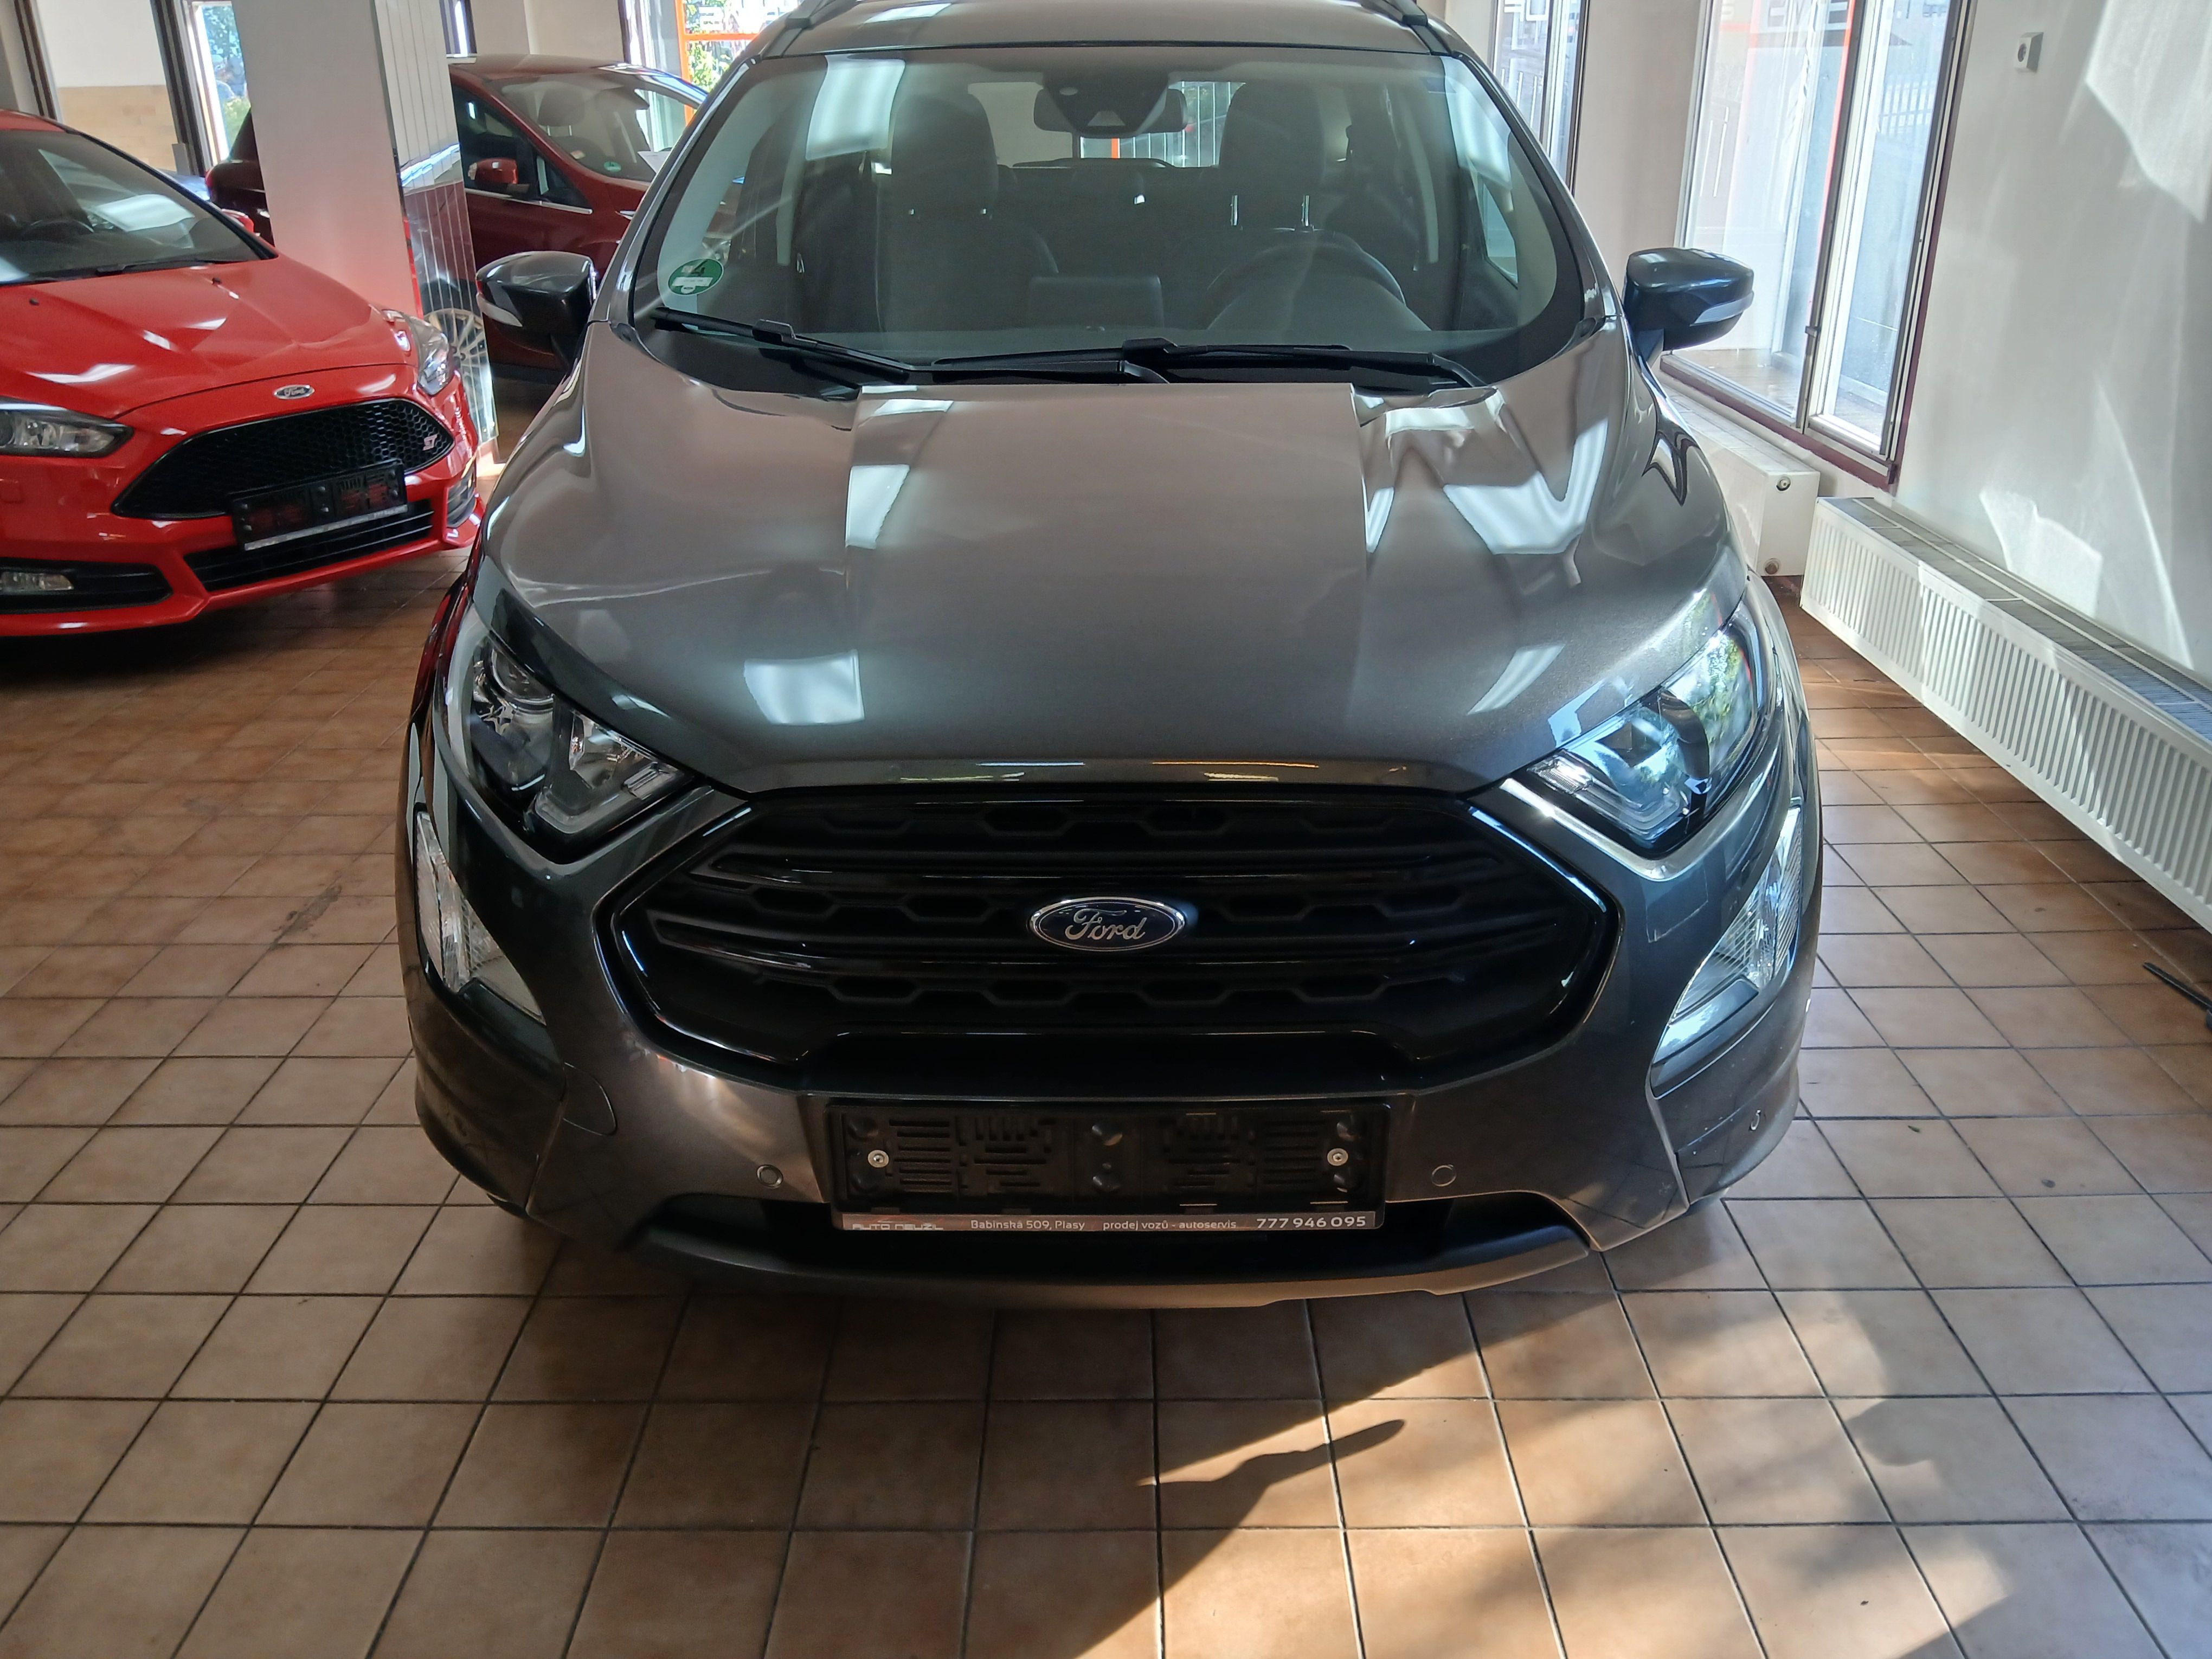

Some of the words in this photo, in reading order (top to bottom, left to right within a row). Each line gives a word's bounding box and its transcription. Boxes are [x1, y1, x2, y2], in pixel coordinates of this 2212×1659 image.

[1065, 909, 1147, 940] Ford
[970, 1220, 1023, 1229] Babinská
[1026, 1220, 1052, 1230] 509,
[1055, 1220, 1085, 1231] Plasy
[1103, 1220, 1139, 1231] prodej
[1141, 1220, 1168, 1229] vozů
[1179, 1219, 1237, 1229] autoservis
[1257, 1218, 1289, 1229] 777
[1293, 1217, 1327, 1228] 946
[1330, 1216, 1366, 1227] 095
